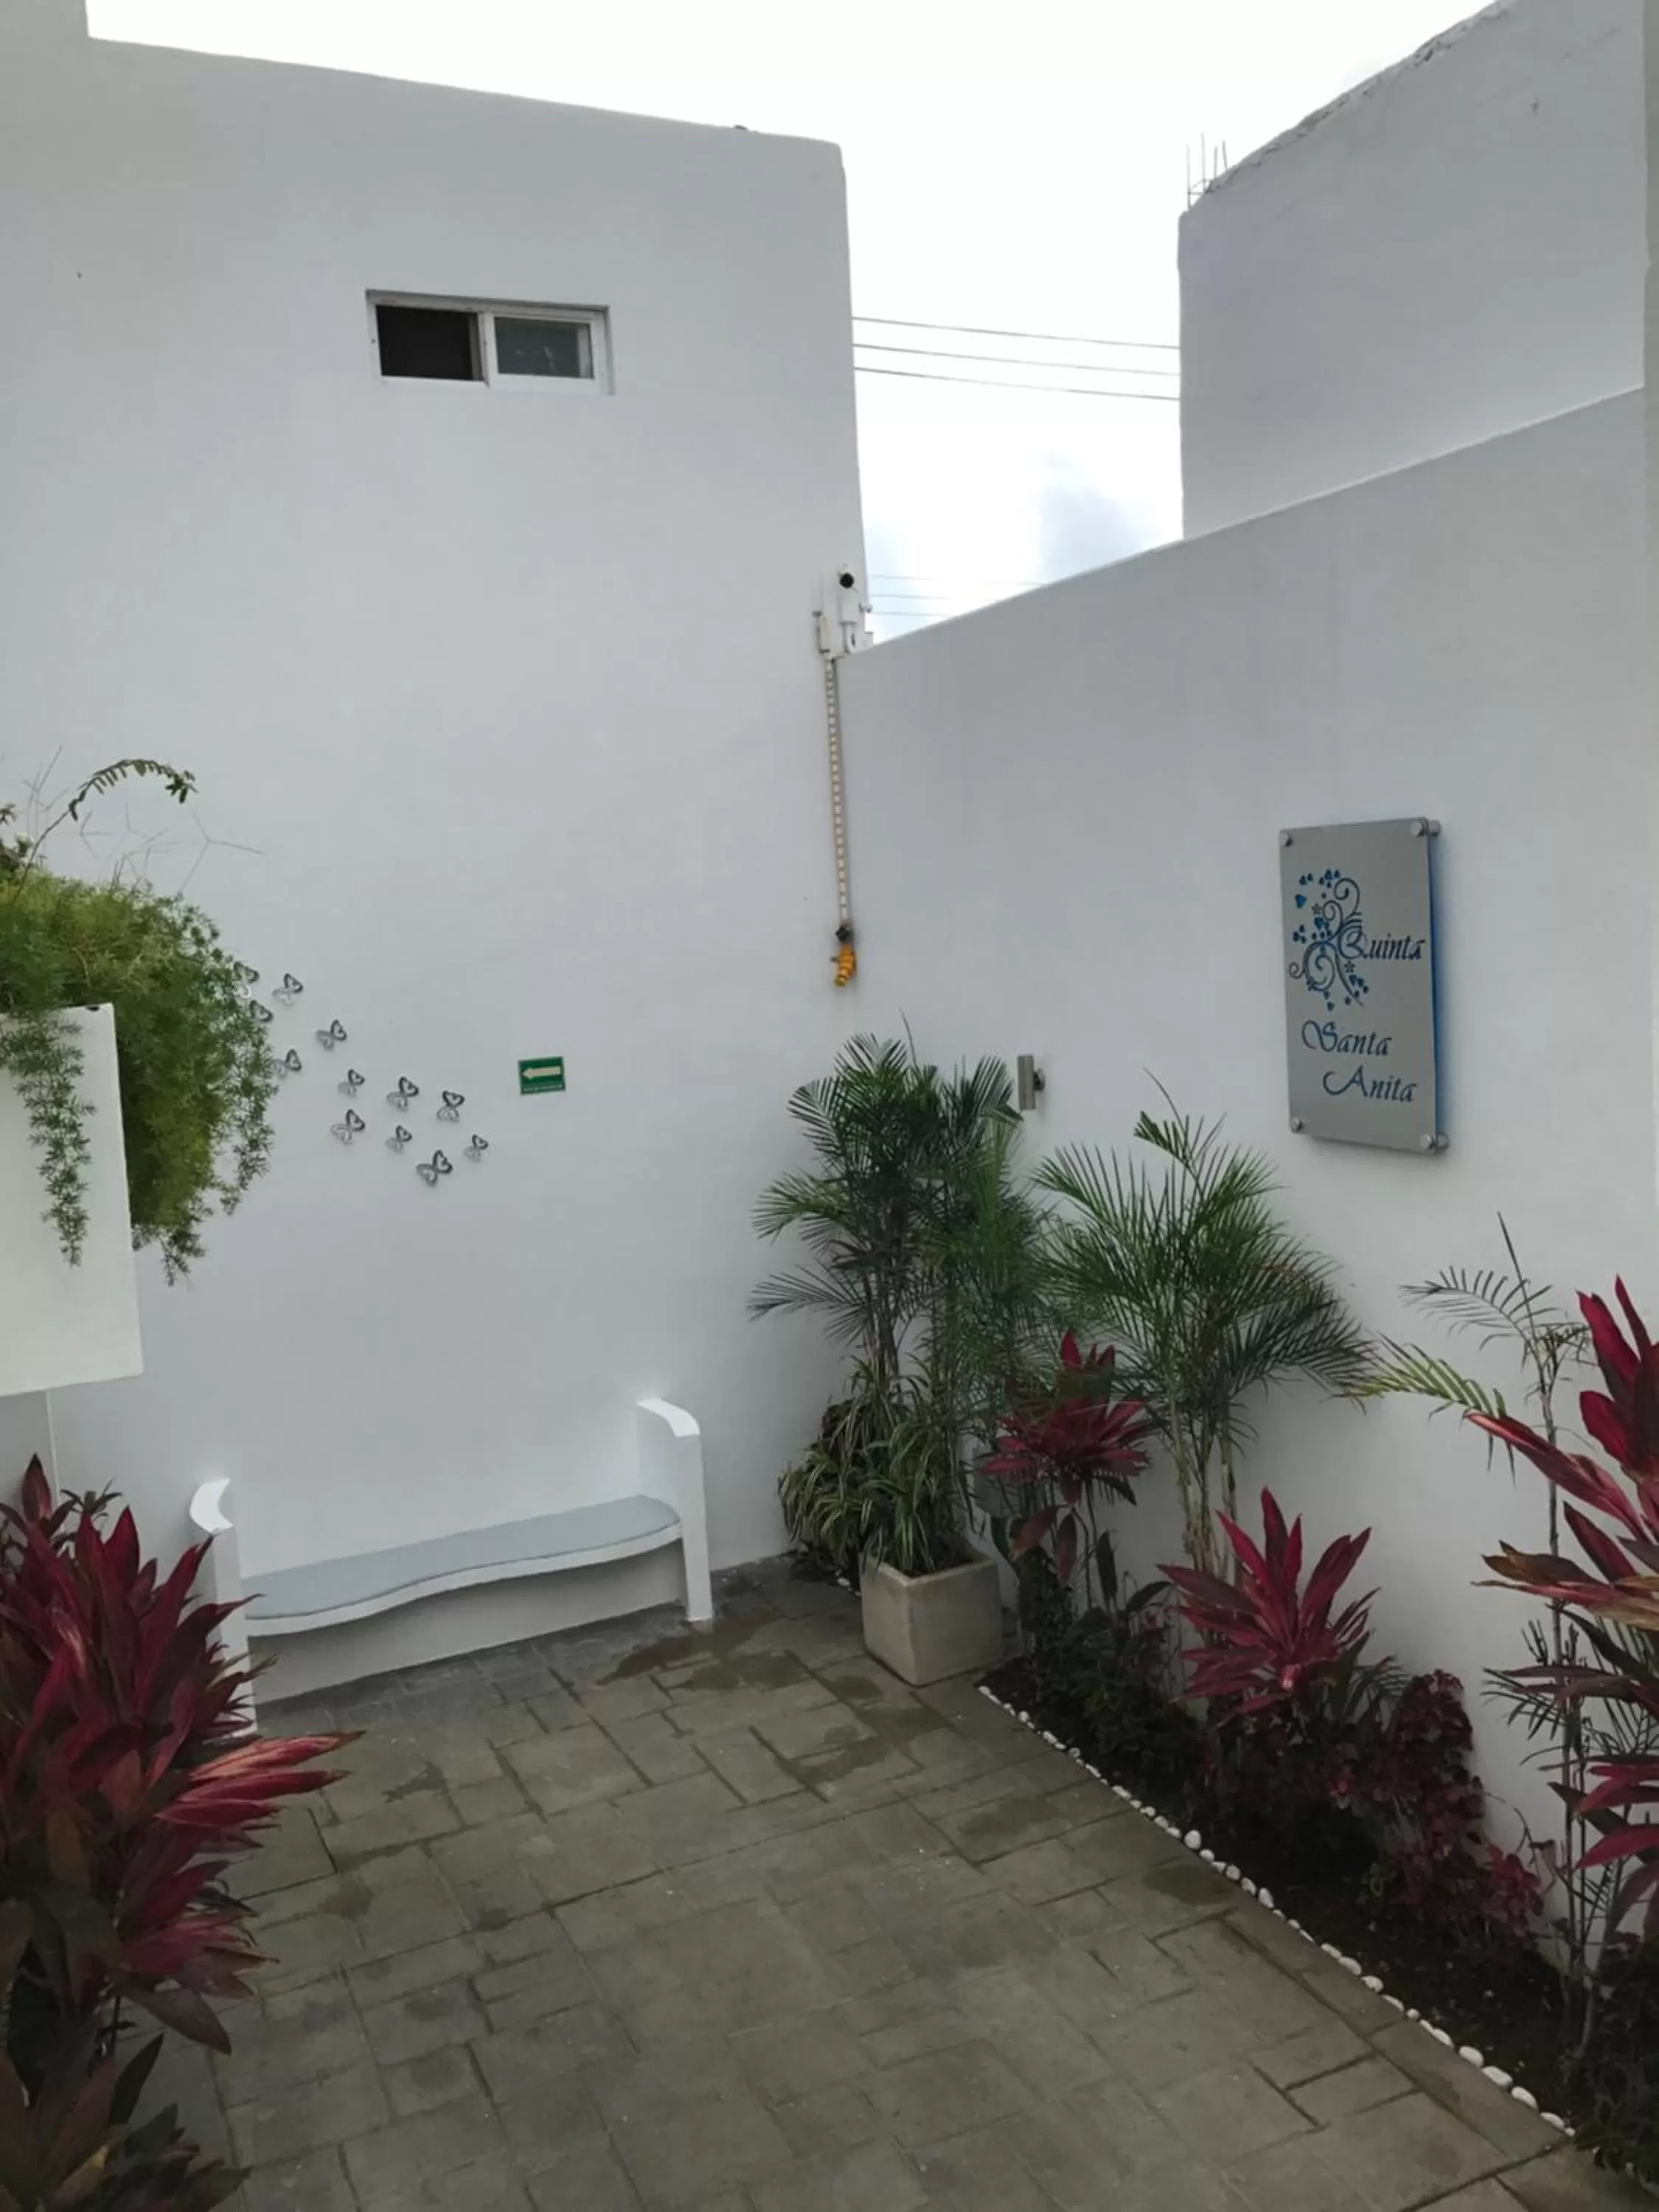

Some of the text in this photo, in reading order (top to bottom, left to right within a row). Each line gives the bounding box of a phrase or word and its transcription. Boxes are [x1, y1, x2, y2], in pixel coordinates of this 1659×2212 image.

[1338, 925, 1425, 960] Quinta
[1301, 1020, 1392, 1056] Santa
[1322, 1065, 1418, 1102] Anita
